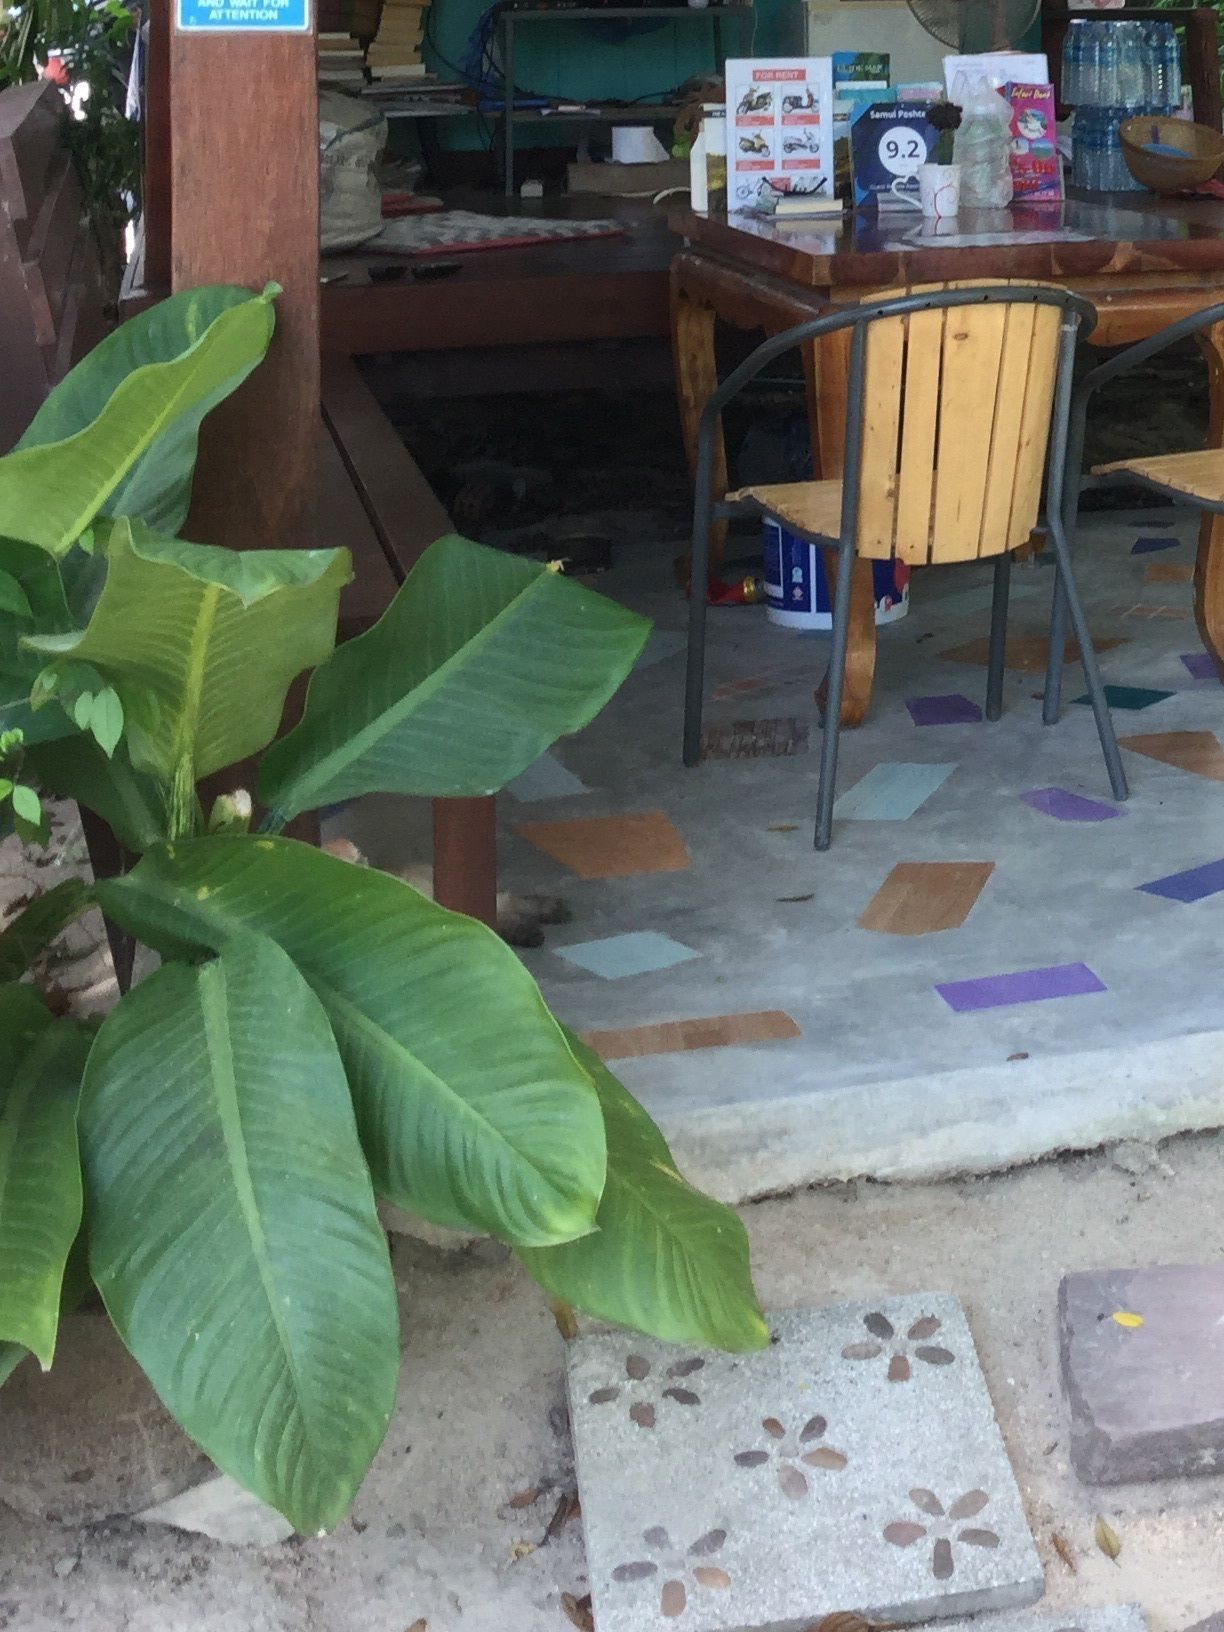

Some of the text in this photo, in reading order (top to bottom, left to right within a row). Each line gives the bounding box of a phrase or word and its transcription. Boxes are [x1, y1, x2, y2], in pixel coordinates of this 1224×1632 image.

[209, 9, 278, 20] ATTENTION
[755, 70, 799, 80] FOR RENT
[869, 109, 926, 120] Samui Poshte
[885, 139, 920, 159] 9.2
